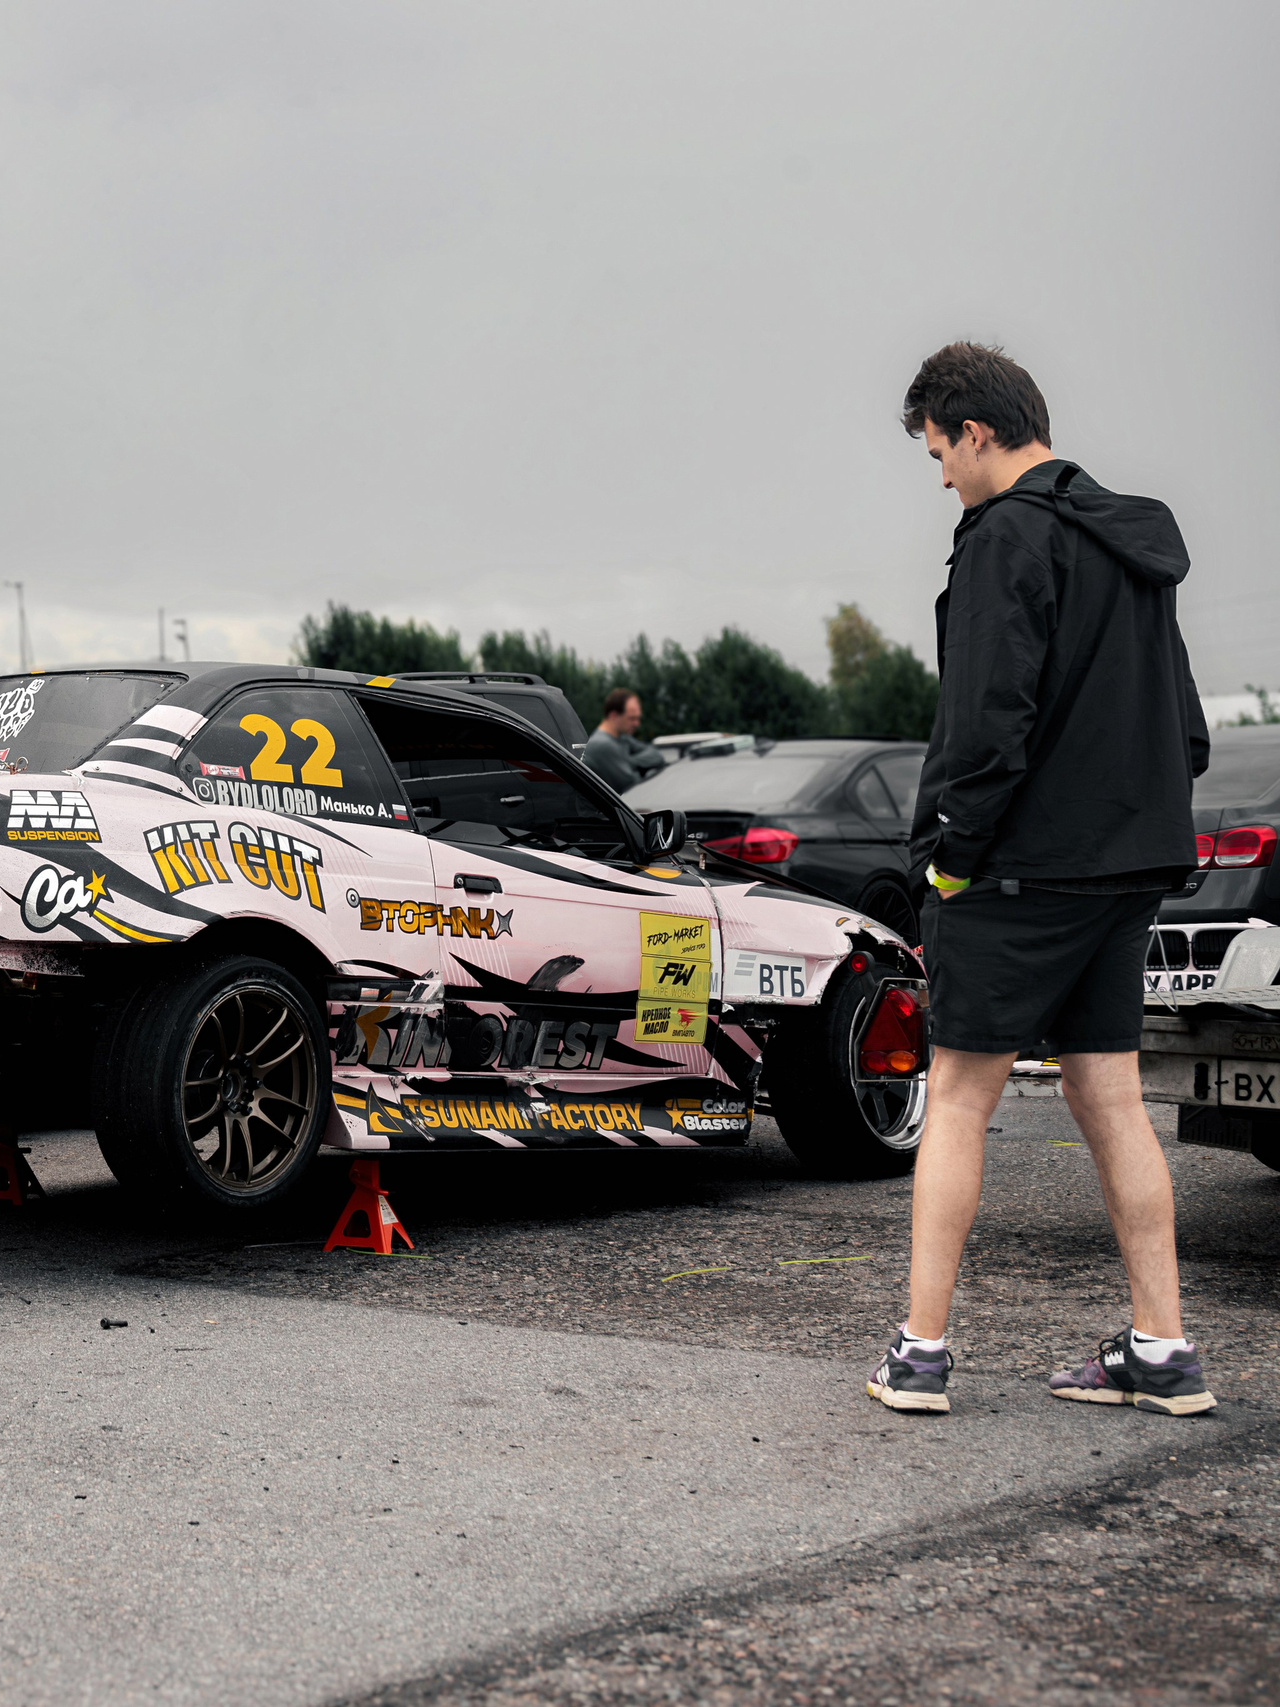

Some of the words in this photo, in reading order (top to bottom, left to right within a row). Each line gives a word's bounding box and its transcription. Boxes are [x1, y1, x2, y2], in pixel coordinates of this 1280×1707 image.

[239, 713, 343, 788] 22
[216, 779, 318, 816] BYDLOLORD
[320, 795, 375, 817] Манько
[7, 830, 100, 841] SUSPENSION
[144, 821, 232, 895] KIT
[228, 822, 325, 912] CUT
[646, 924, 704, 947] FORD-MARKET
[759, 963, 805, 997] ВТБ
[653, 986, 669, 997] PIPE
[671, 988, 696, 999] WORKS
[643, 1020, 669, 1035] МАСЛО
[702, 1099, 746, 1115] Color
[684, 1114, 747, 1132] Blaster
